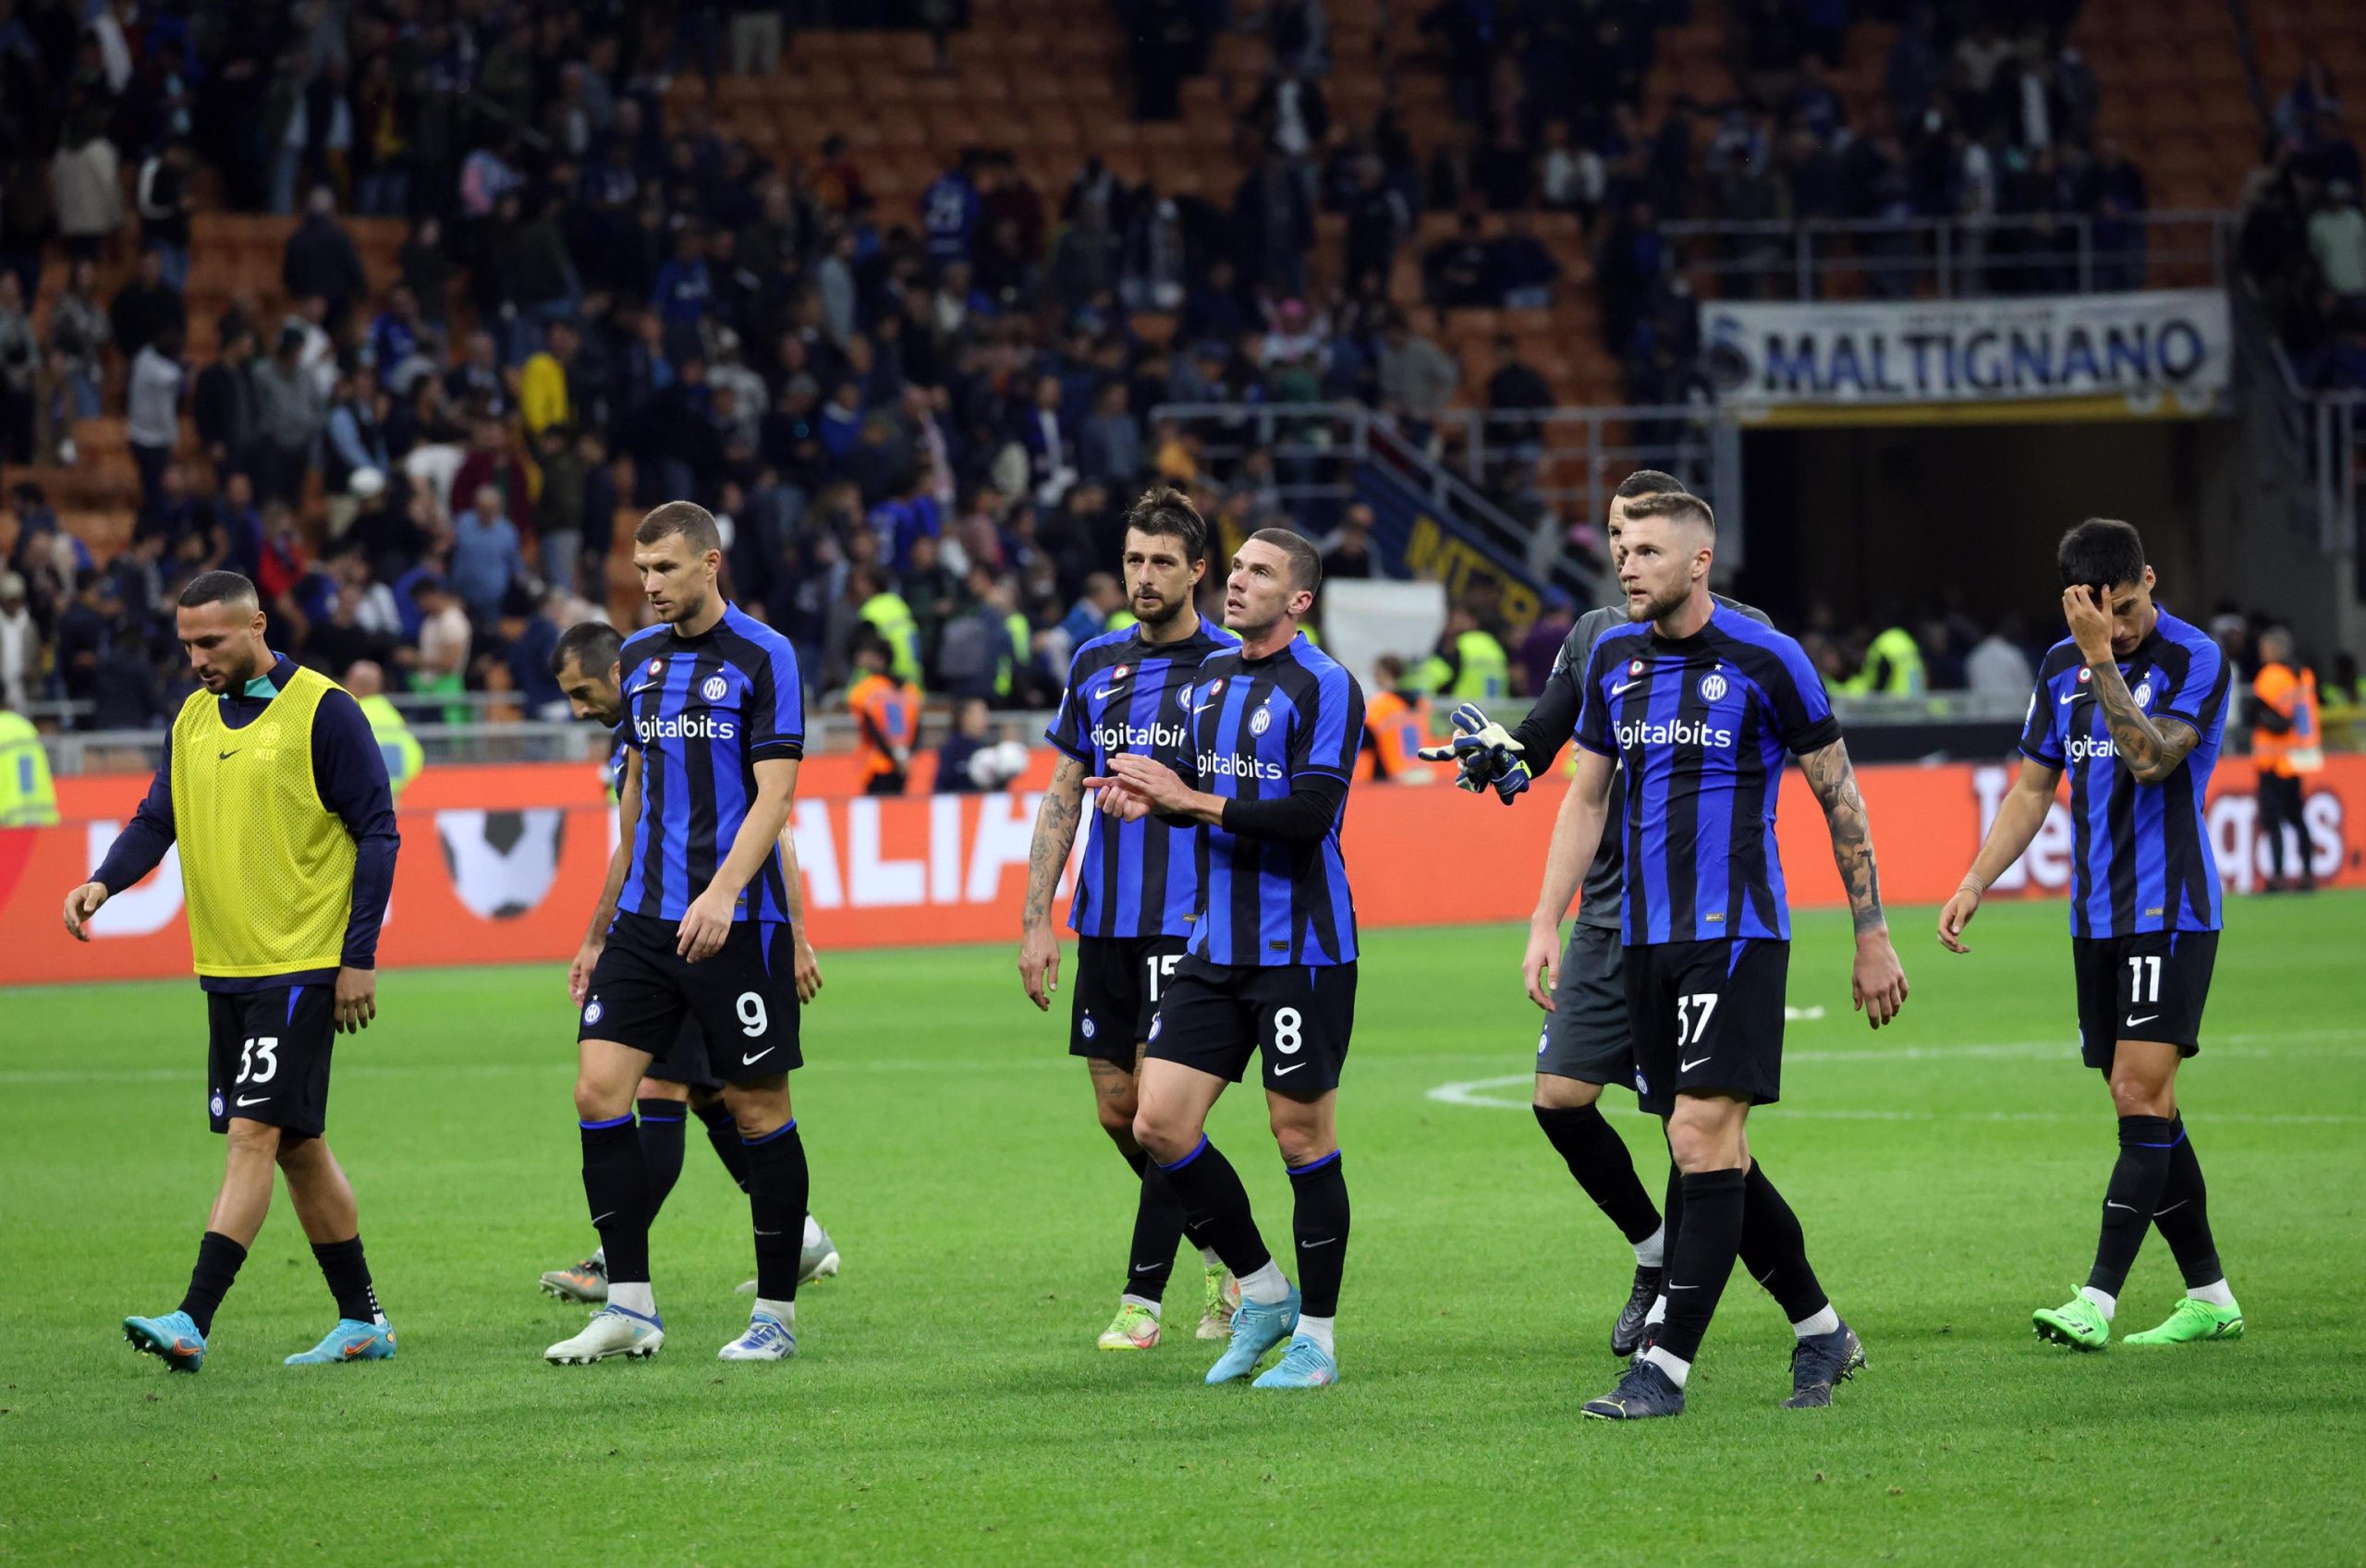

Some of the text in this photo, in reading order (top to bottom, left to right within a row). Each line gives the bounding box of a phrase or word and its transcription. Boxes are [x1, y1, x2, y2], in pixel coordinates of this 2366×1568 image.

[1763, 318, 2206, 393] MALTIGNANO
[1198, 749, 1283, 780] gitalbits
[2128, 955, 2161, 1003] 11
[736, 991, 768, 1038] 9
[1274, 1006, 1302, 1054] 8
[1677, 992, 1718, 1047] 37
[236, 1037, 278, 1084] 33
